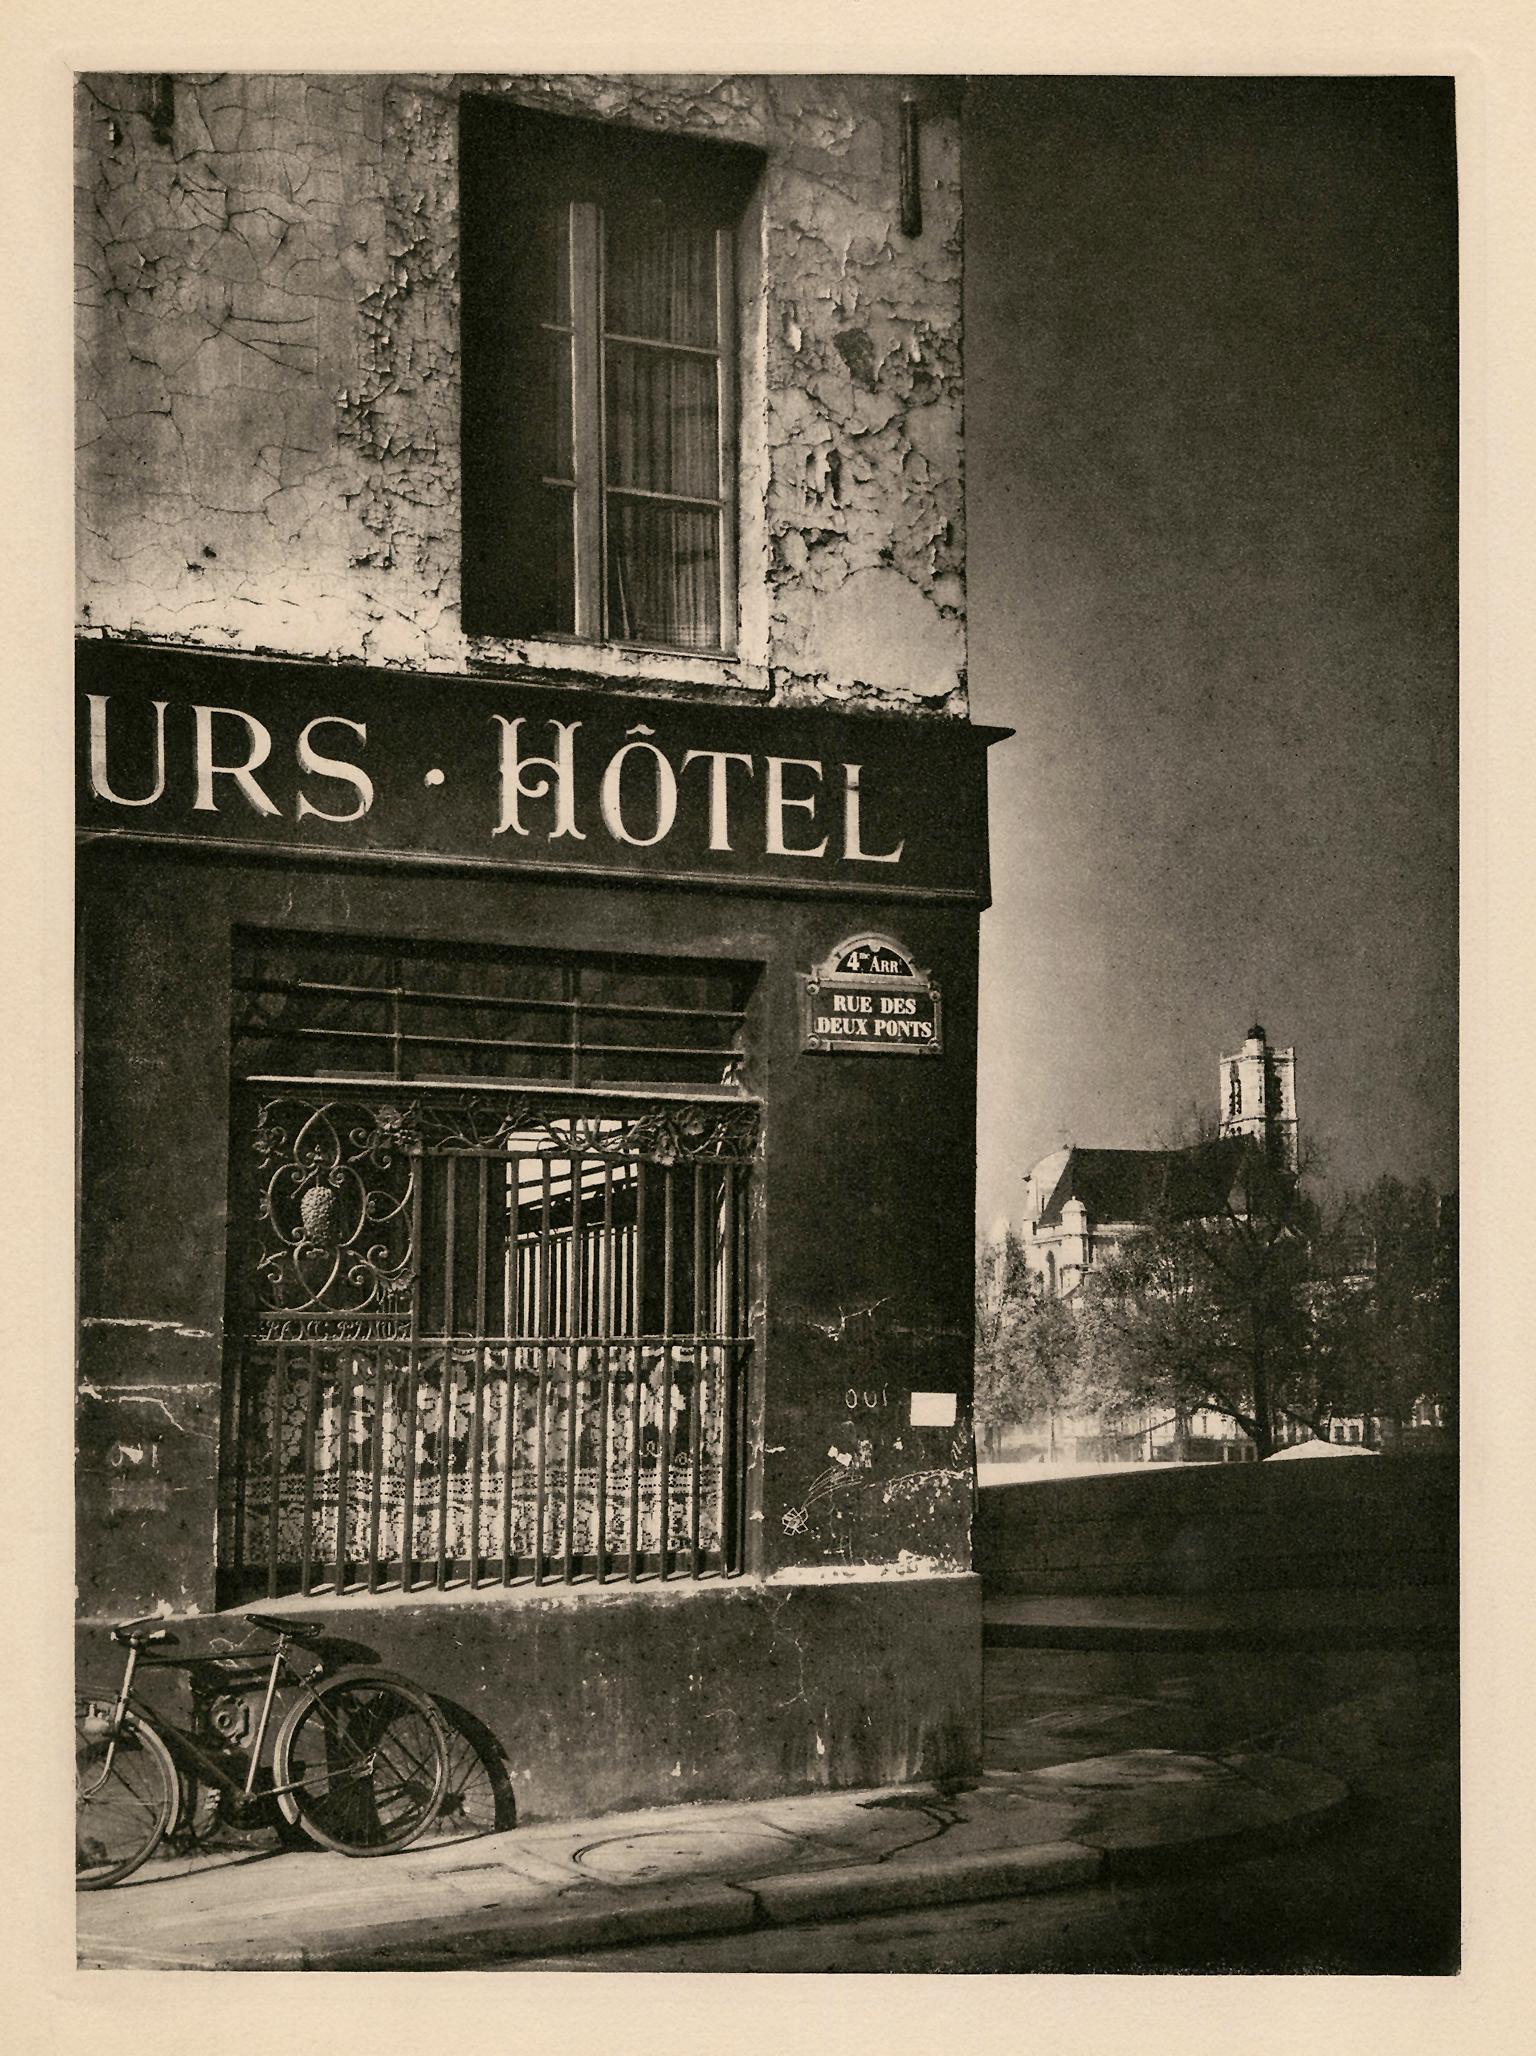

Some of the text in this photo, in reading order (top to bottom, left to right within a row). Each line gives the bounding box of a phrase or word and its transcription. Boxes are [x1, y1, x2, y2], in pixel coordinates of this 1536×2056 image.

[85, 693, 905, 863] URS HÔTEL
[833, 994, 917, 1015] RUE DES
[815, 1016, 932, 1038] DEUX PONTS
